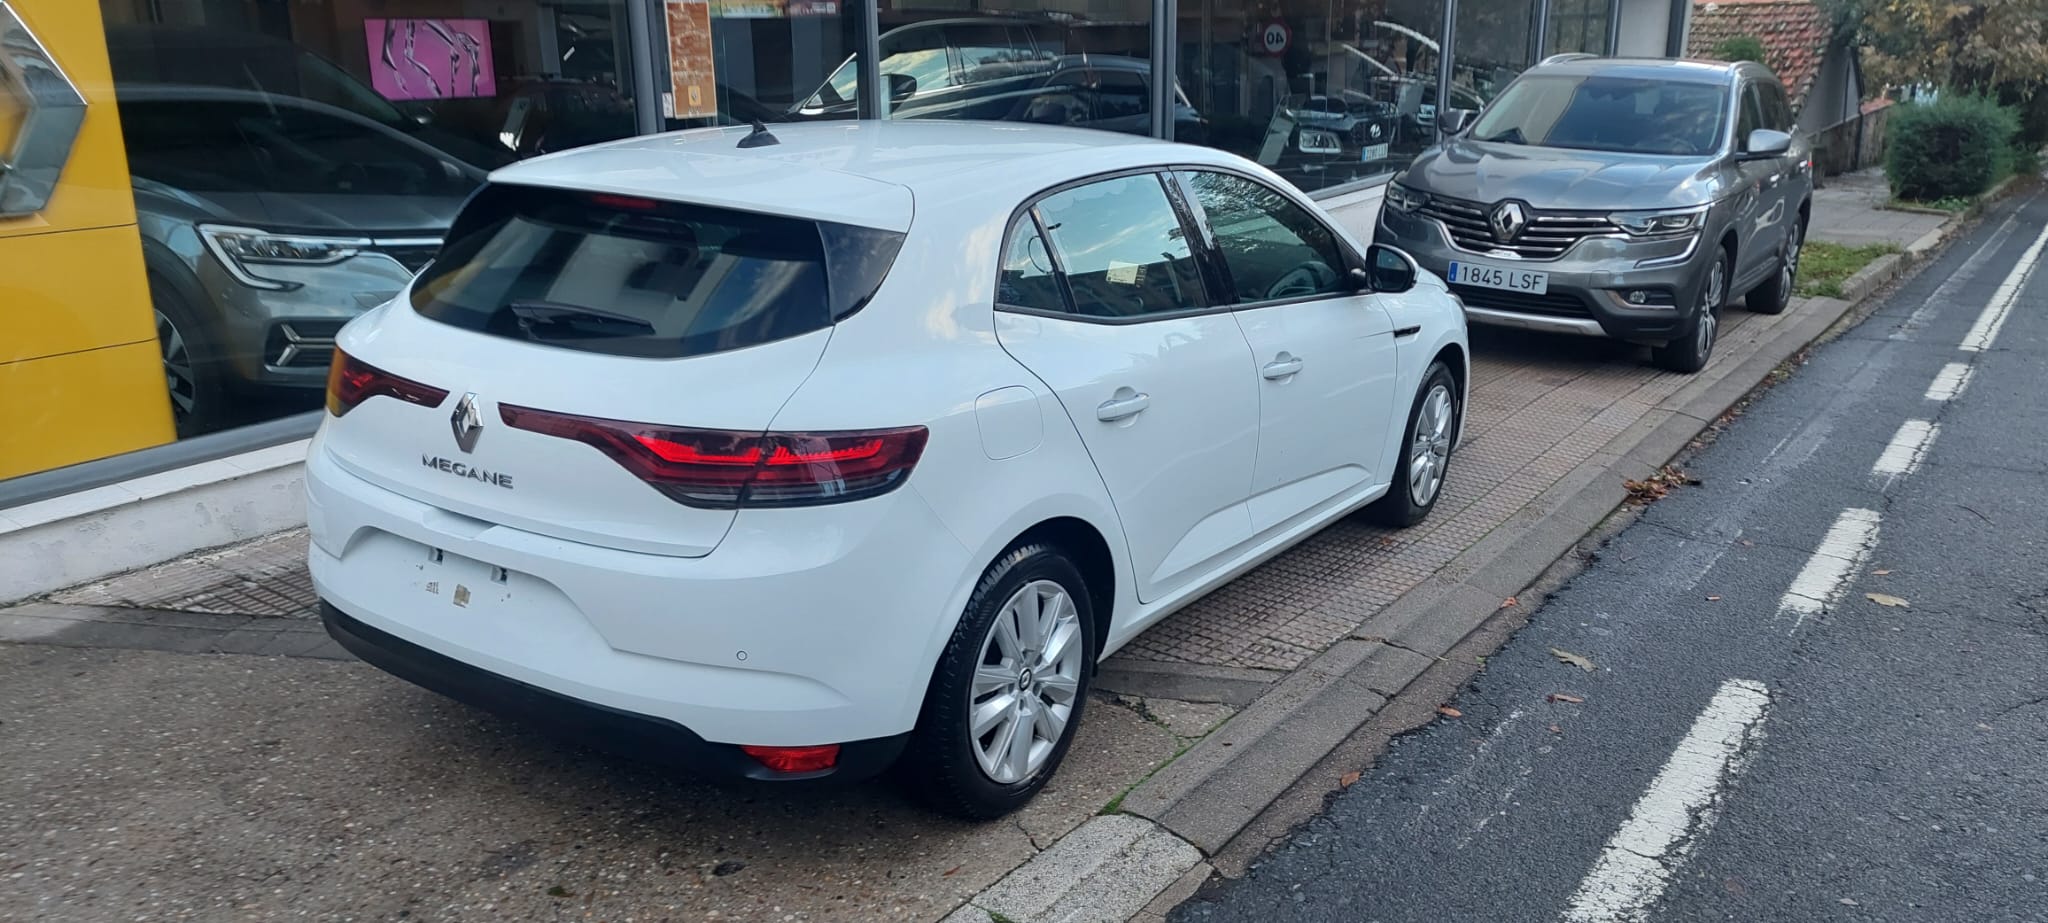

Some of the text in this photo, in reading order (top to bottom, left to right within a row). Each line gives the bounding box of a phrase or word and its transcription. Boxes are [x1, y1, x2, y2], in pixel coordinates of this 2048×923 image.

[1462, 266, 1544, 291] 1845 LSF
[422, 453, 514, 490] MEGANE
